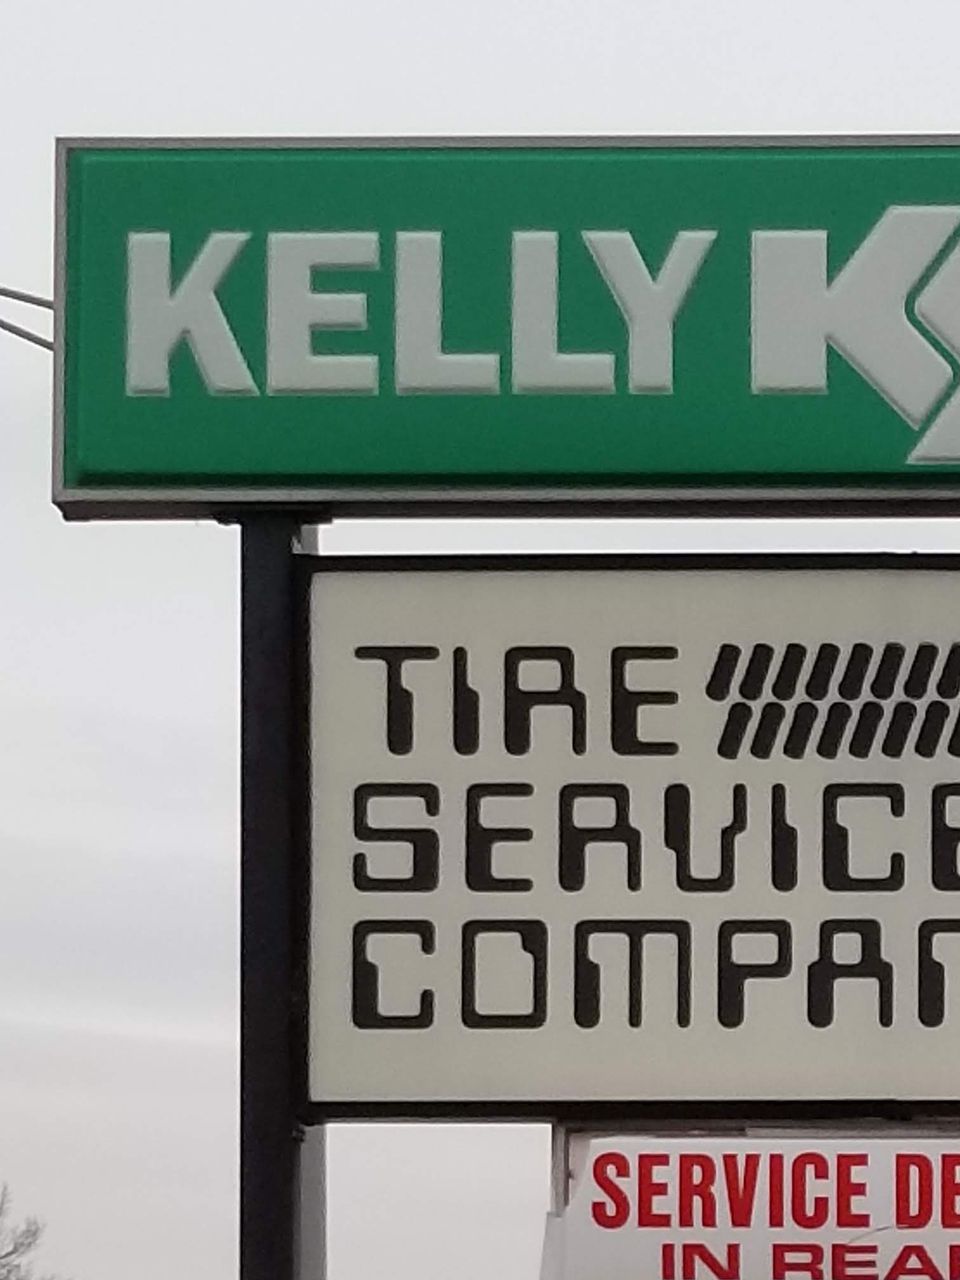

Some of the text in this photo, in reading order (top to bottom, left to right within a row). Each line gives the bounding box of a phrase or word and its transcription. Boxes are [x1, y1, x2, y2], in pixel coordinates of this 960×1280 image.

[125, 230, 718, 392] KELLY
[353, 645, 681, 757] TIRE
[590, 1151, 871, 1230] SERVICE
